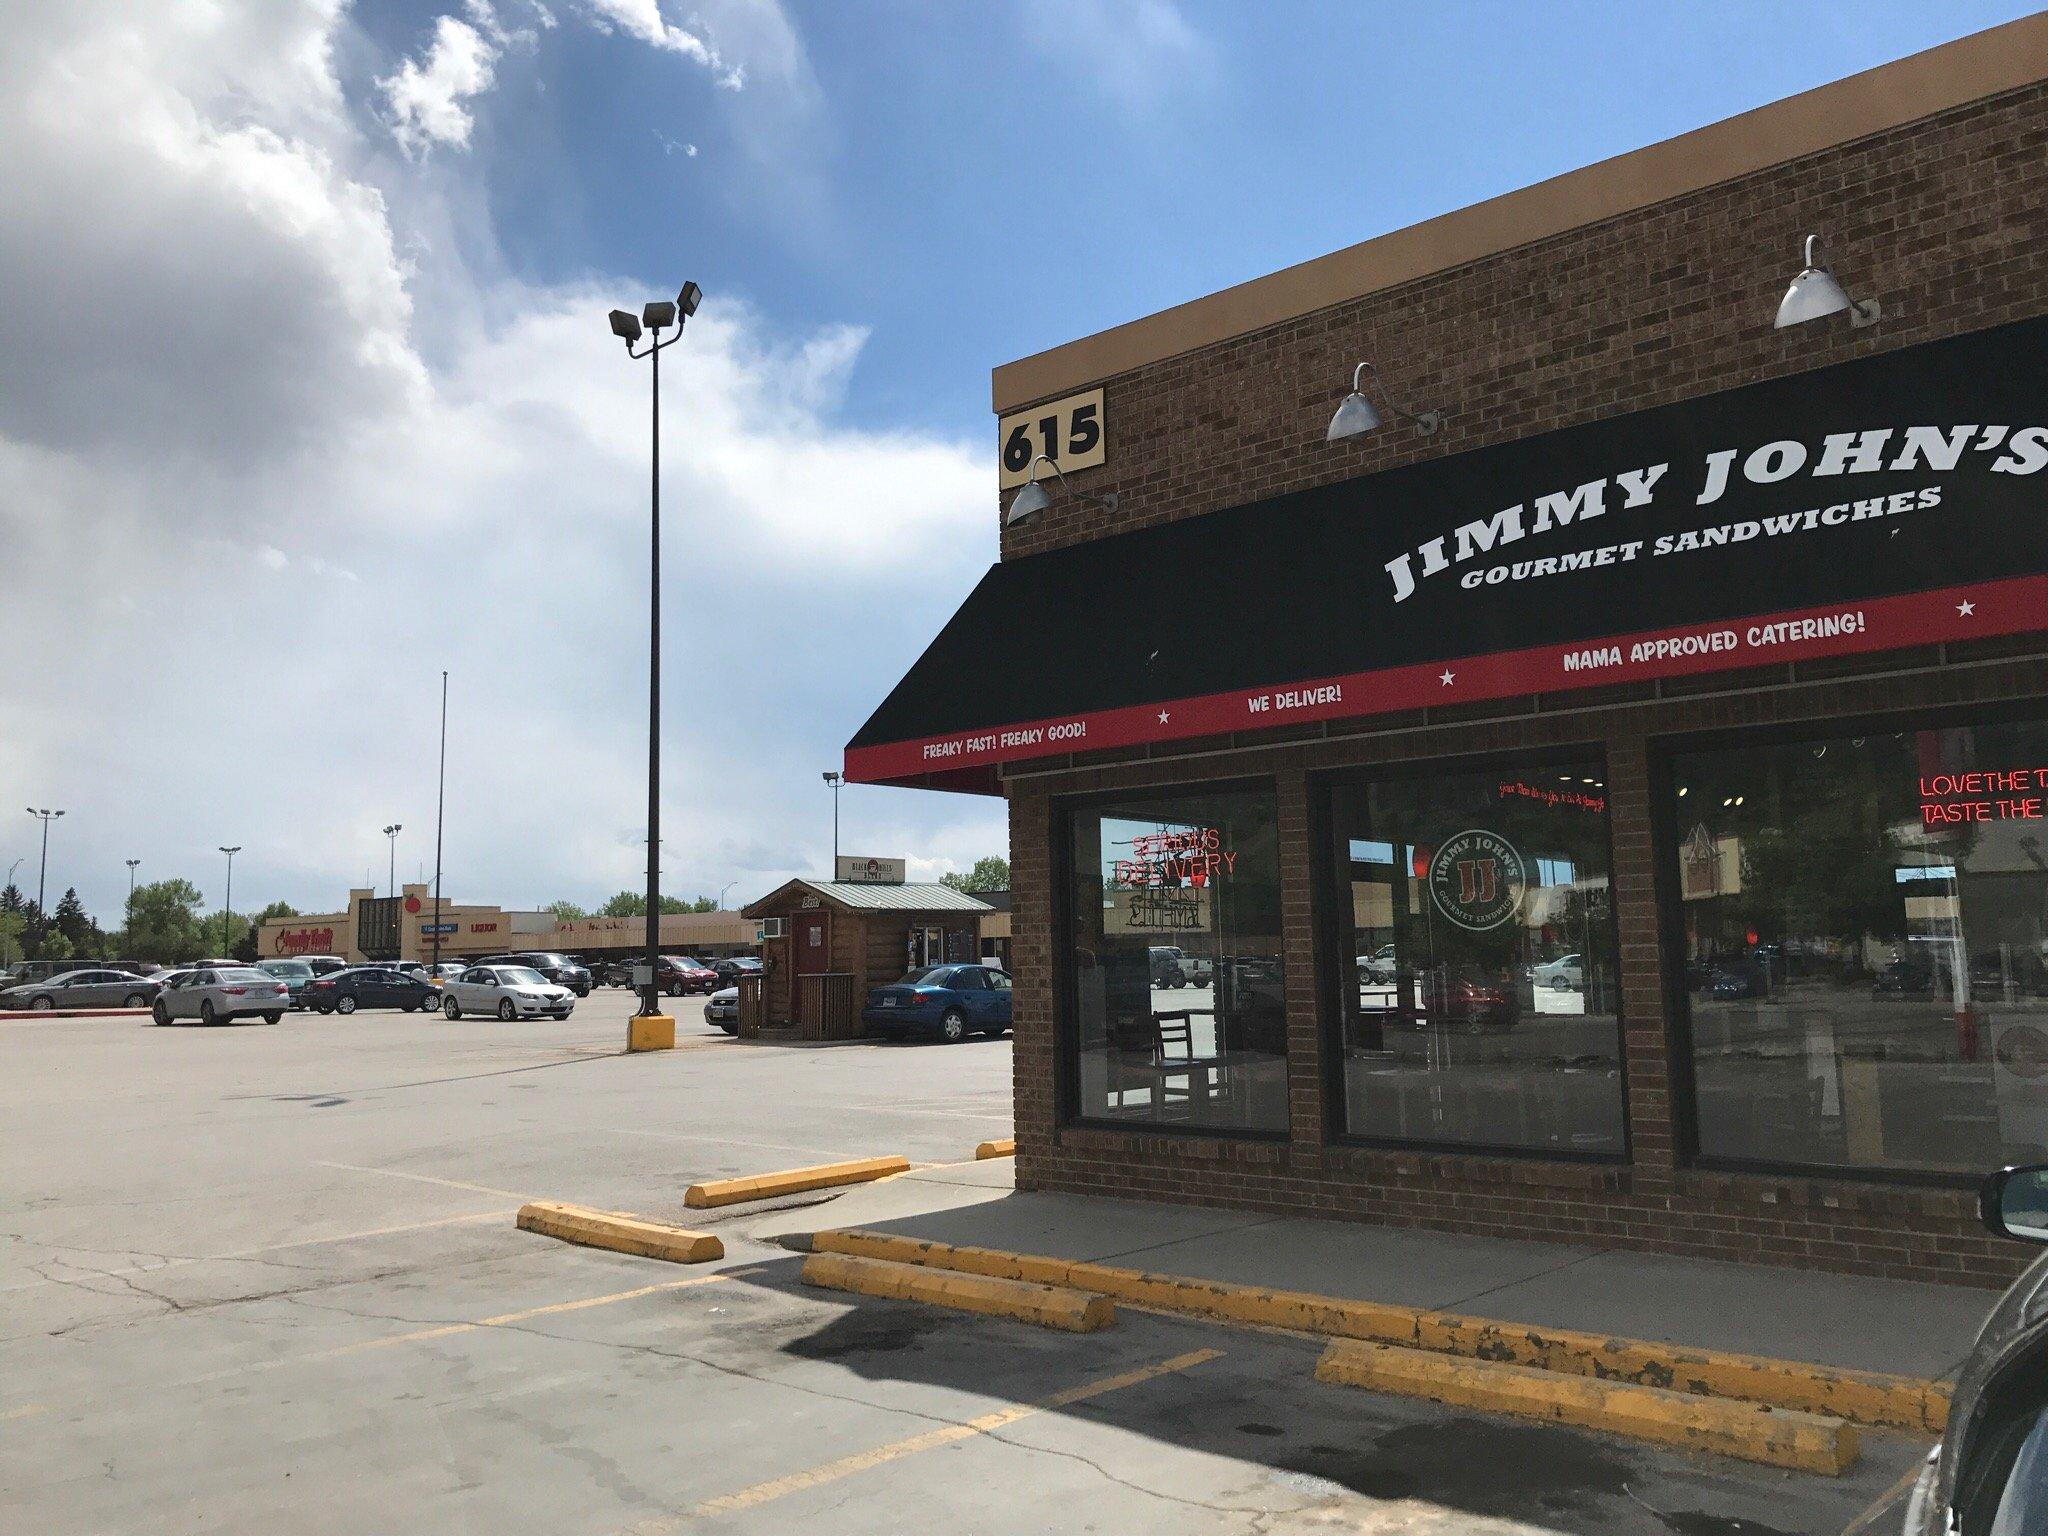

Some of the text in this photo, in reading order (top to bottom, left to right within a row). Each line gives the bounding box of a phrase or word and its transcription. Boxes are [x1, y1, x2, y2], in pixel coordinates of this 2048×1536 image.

[1003, 403, 1100, 473] 615
[1384, 424, 2048, 603] JIMMY JOHN'S
[1460, 485, 1942, 589] GOURMET SANDWICHES
[1563, 611, 1866, 672] MAMA APPROVED CATERING!
[1247, 684, 1342, 713] WE DELIVER!
[923, 721, 1087, 759] FREAKY FAST! FREAKY GOOD!
[1920, 798, 2044, 824] TASTE THE
[1115, 851, 1238, 886] DELIVERY
[1436, 837, 1519, 882] JIMMY JOHN'S
[470, 923, 498, 933] LIQUOR
